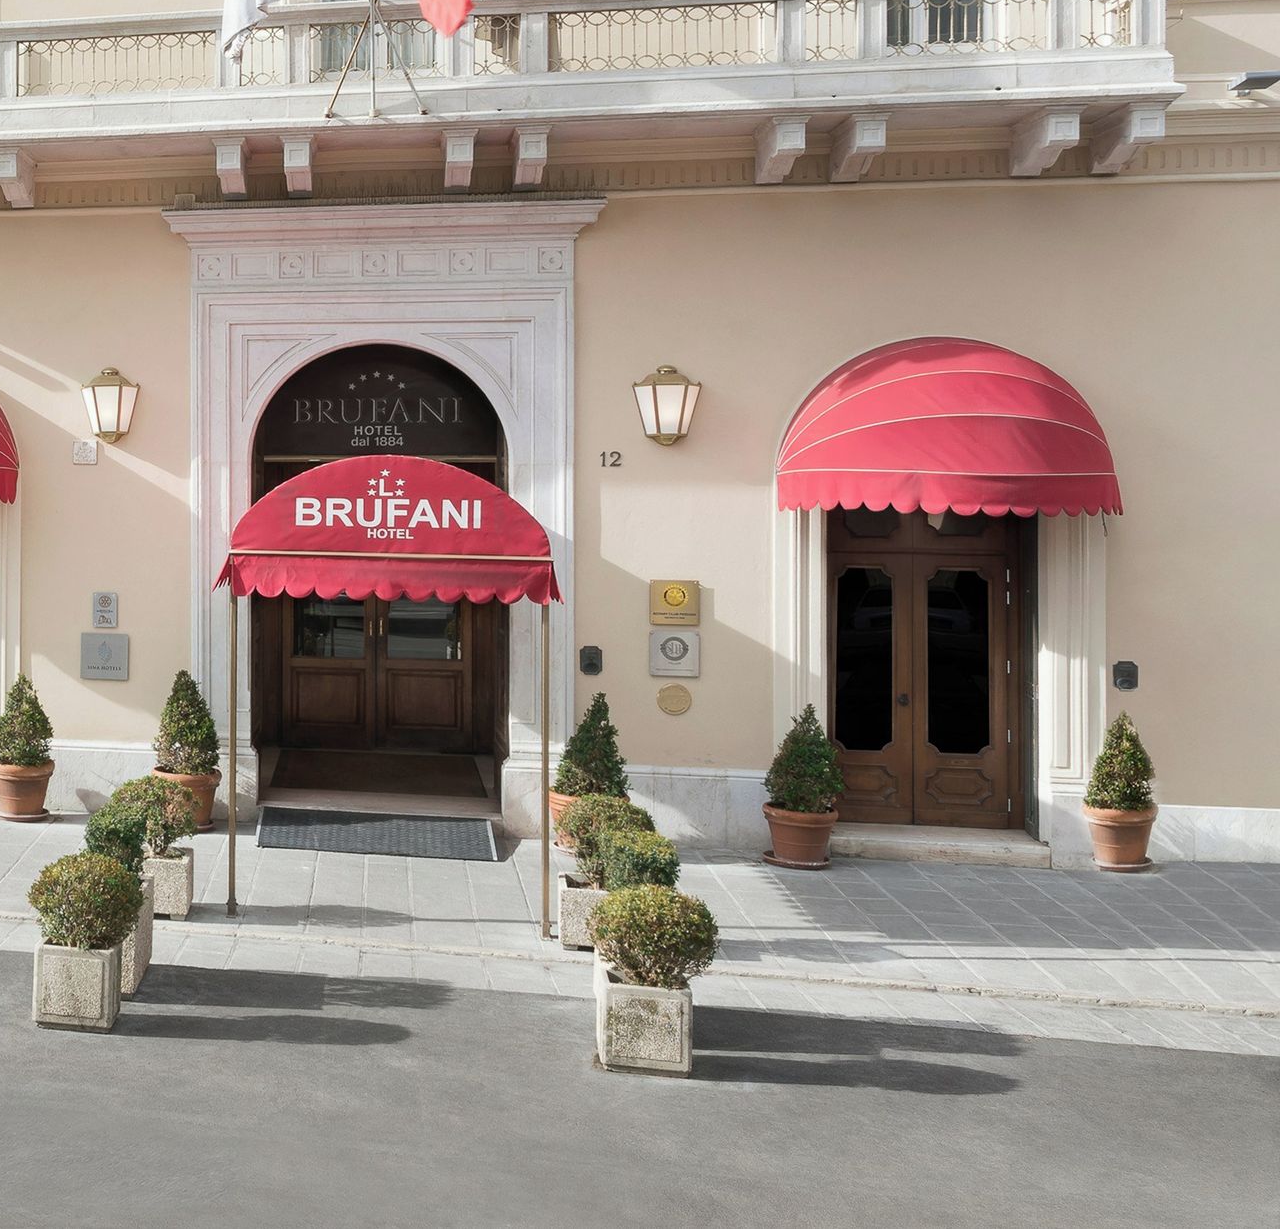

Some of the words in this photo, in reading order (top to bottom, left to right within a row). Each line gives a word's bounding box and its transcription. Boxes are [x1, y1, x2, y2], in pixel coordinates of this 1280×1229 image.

[293, 397, 463, 424] BRUFANI
[354, 425, 402, 436] HOTEL
[351, 436, 370, 447] dal
[374, 436, 404, 447] 1884
[599, 451, 622, 468] 12
[378, 478, 394, 497] L
[295, 497, 482, 529] BRUFANI
[367, 528, 414, 540] HOTEL
